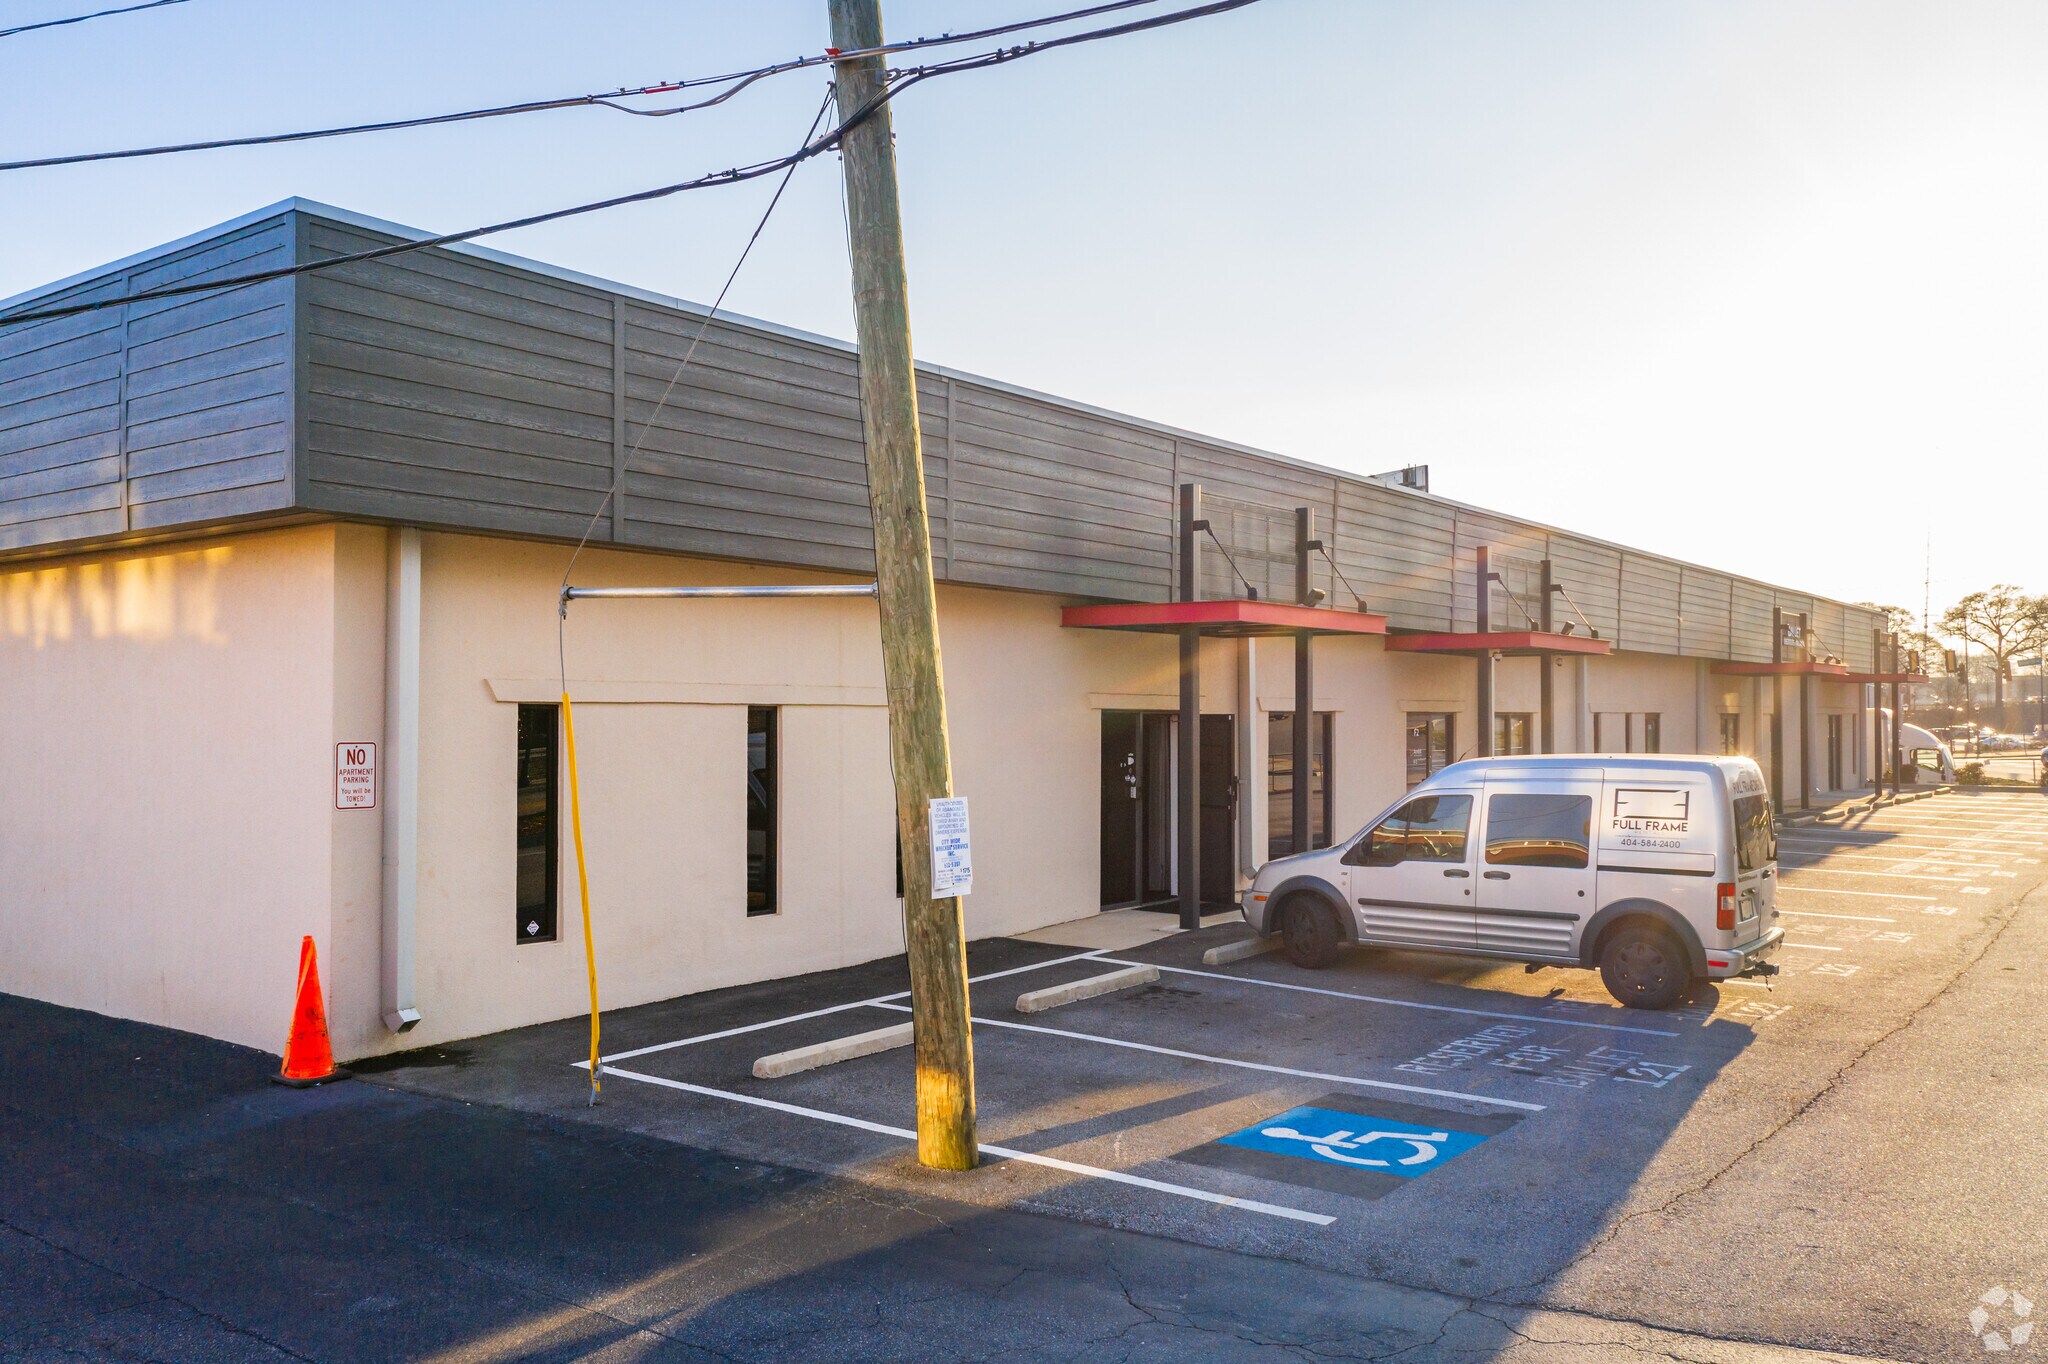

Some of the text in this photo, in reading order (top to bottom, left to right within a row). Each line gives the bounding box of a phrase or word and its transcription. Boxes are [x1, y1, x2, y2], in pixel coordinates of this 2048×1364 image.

[347, 749, 366, 765] NO
[343, 776, 369, 784] PARKING
[1612, 819, 1689, 832] FULL FRAME
[1620, 838, 1681, 849] 404-584-2400
[1392, 1025, 1536, 1075] RESERVED
[1487, 1045, 1571, 1071] FOR
[1613, 1061, 1693, 1089] 121
